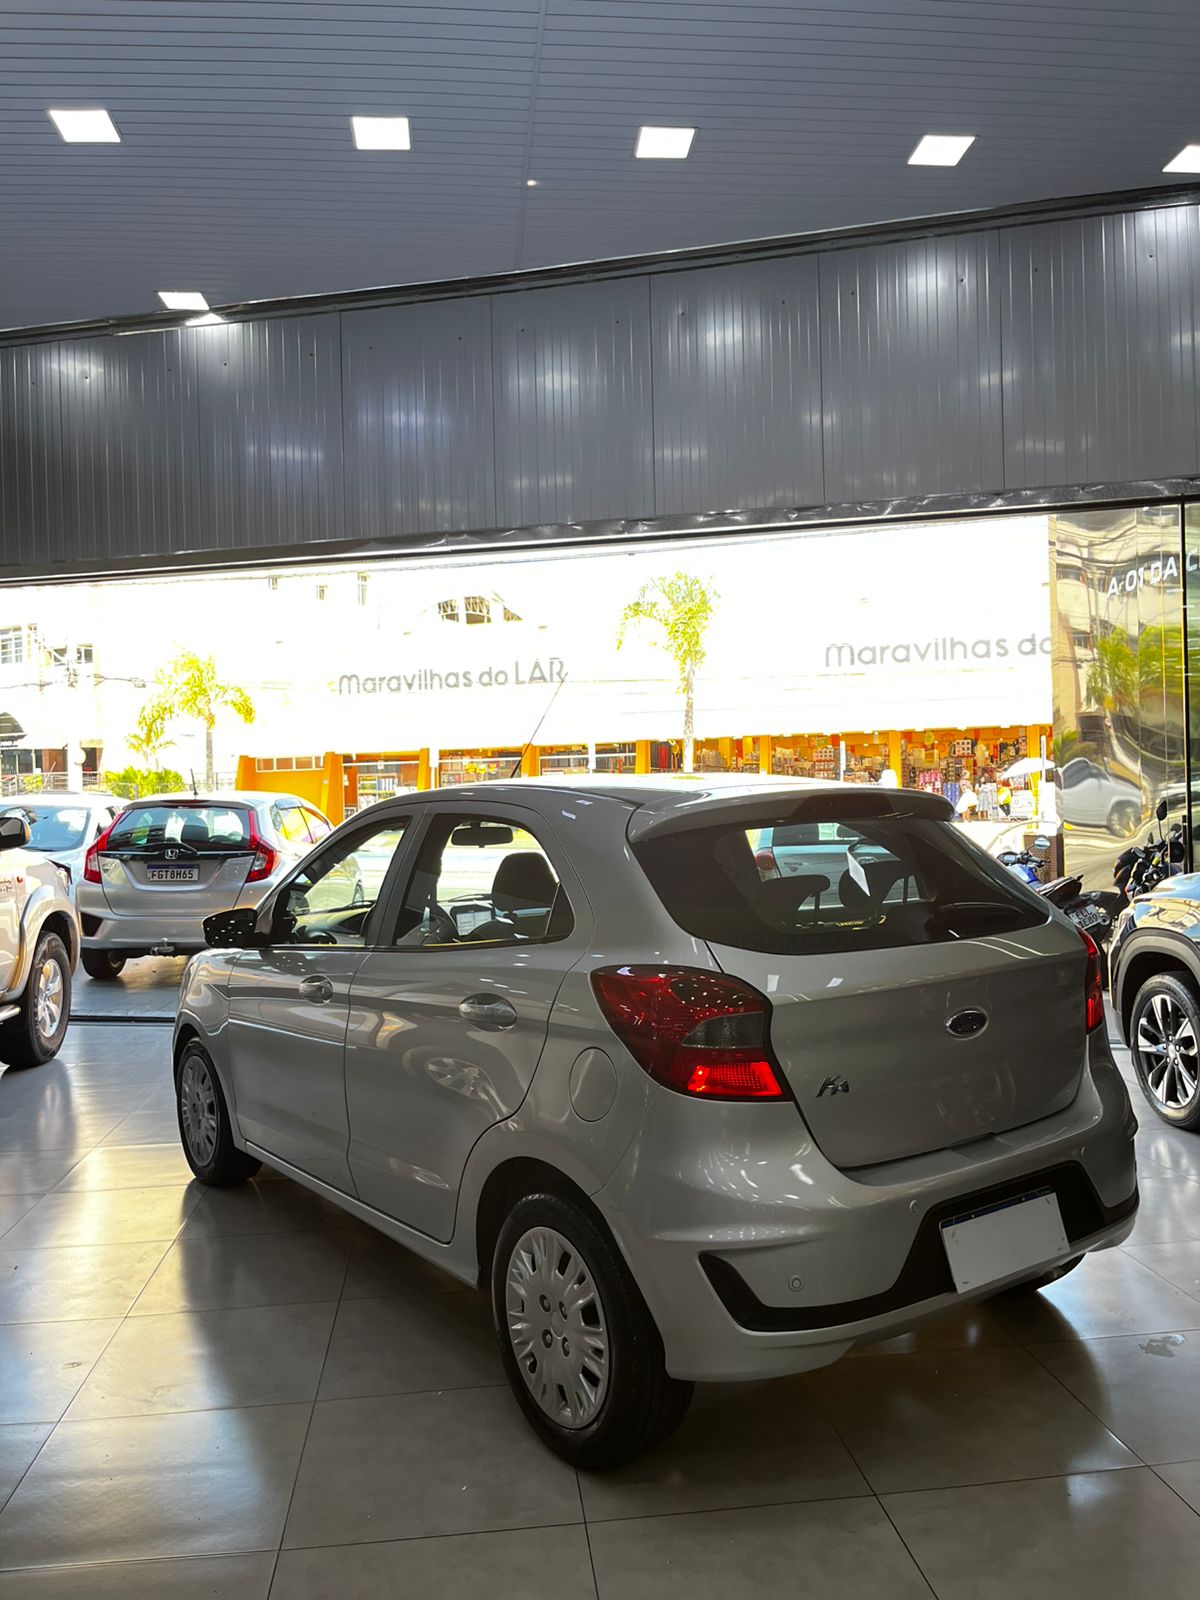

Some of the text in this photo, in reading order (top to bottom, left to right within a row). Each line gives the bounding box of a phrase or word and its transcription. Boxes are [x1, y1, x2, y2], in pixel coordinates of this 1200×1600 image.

[825, 636, 1009, 667] maravilhas
[339, 657, 565, 695] maravilhas do LAR
[151, 869, 194, 879] FGT8H65
